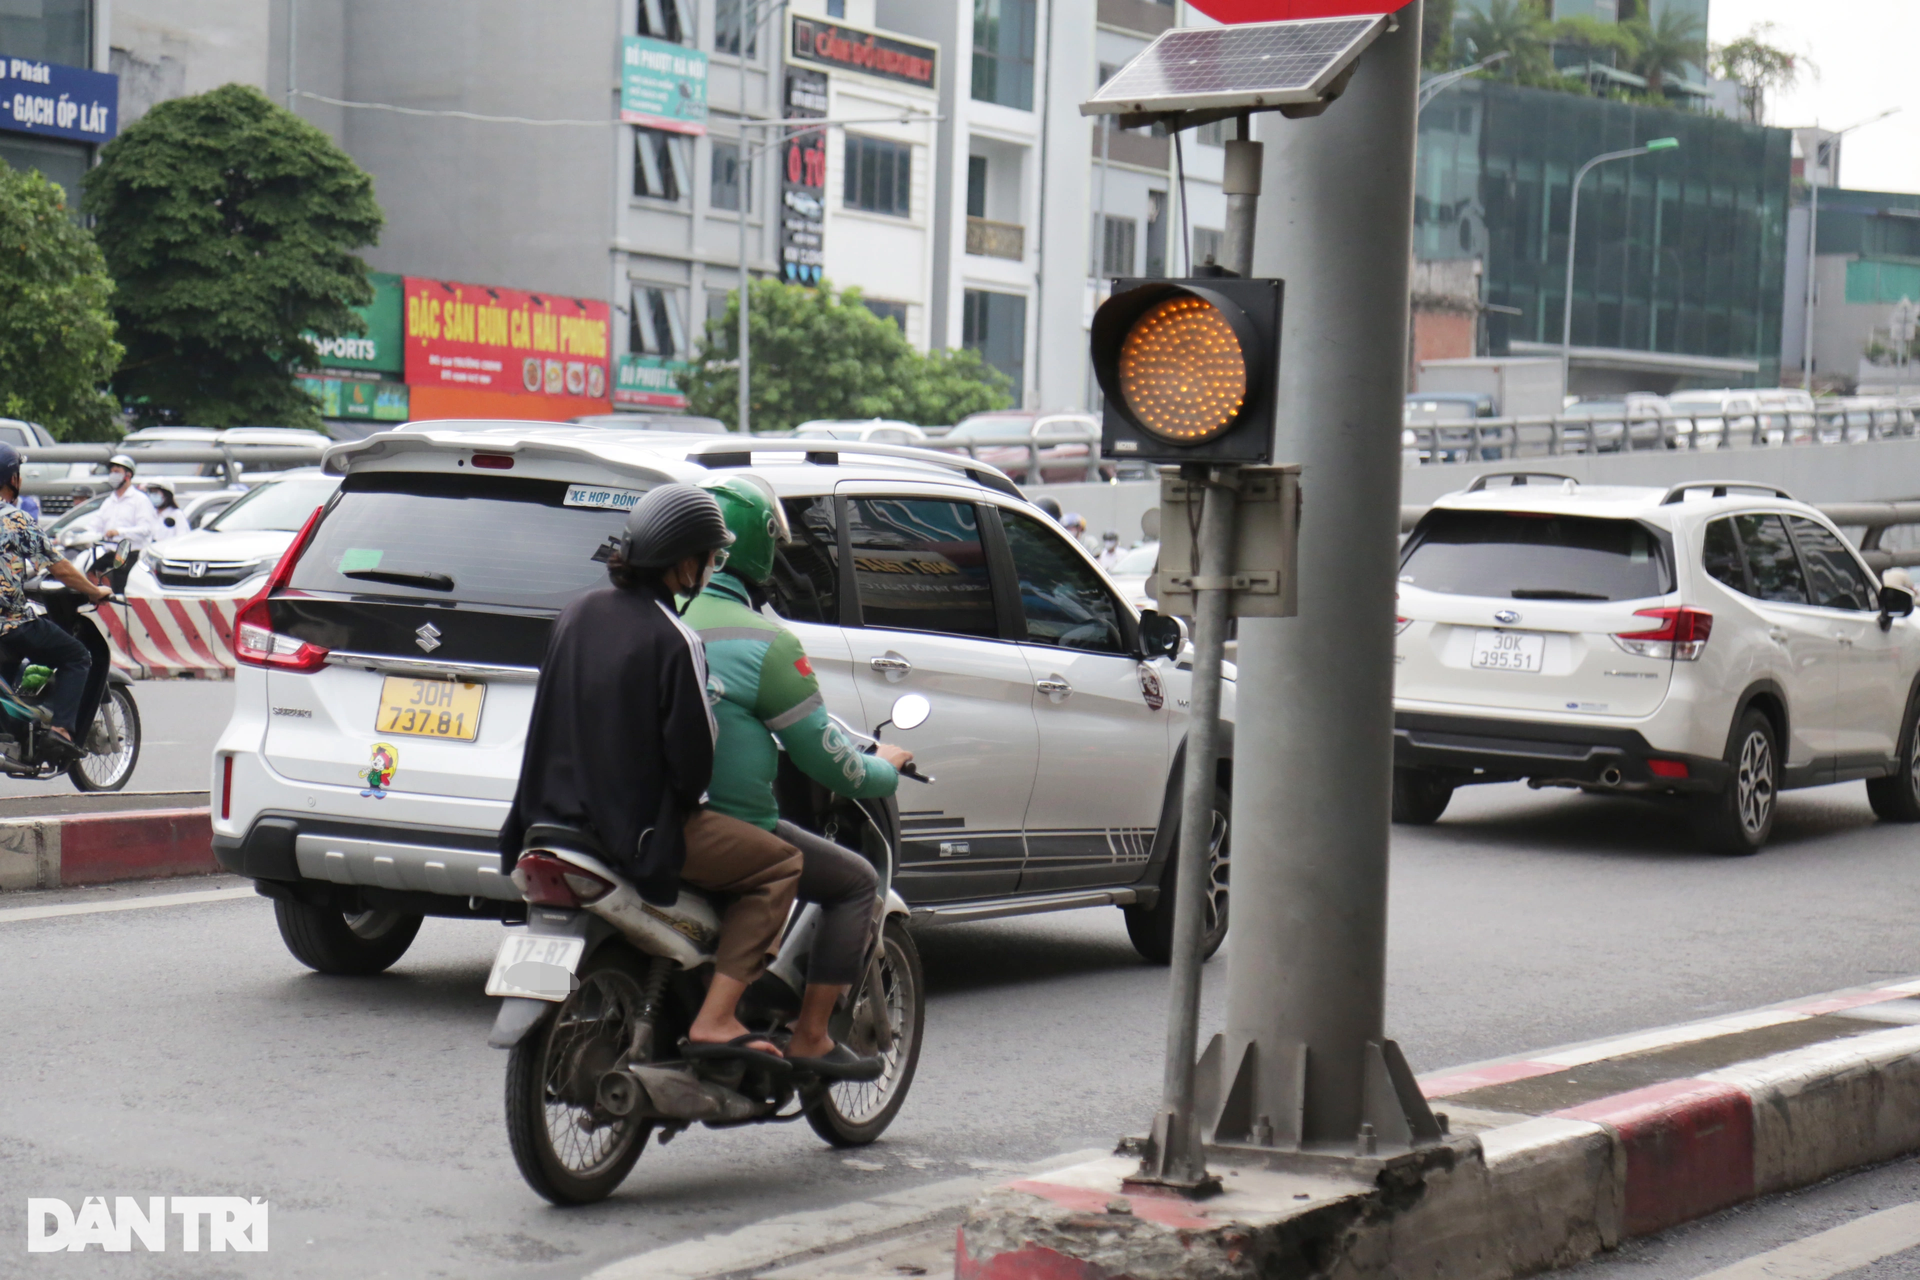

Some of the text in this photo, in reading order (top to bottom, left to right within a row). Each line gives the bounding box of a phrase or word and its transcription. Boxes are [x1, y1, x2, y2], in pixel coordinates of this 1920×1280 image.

[10, 58, 51, 85] Phát
[13, 93, 54, 128] GẠCH
[57, 92, 78, 129] ỐP
[80, 100, 108, 134] LÁT
[408, 289, 607, 359] ĐẶC SẢN BÚN CÁ HẢI PHÒNG
[571, 490, 587, 502] XE
[588, 491, 611, 506] HỢP
[1493, 634, 1523, 651] 30K
[1479, 650, 1532, 669] 395.51
[409, 680, 455, 708] 30H
[389, 706, 465, 736] 737.81
